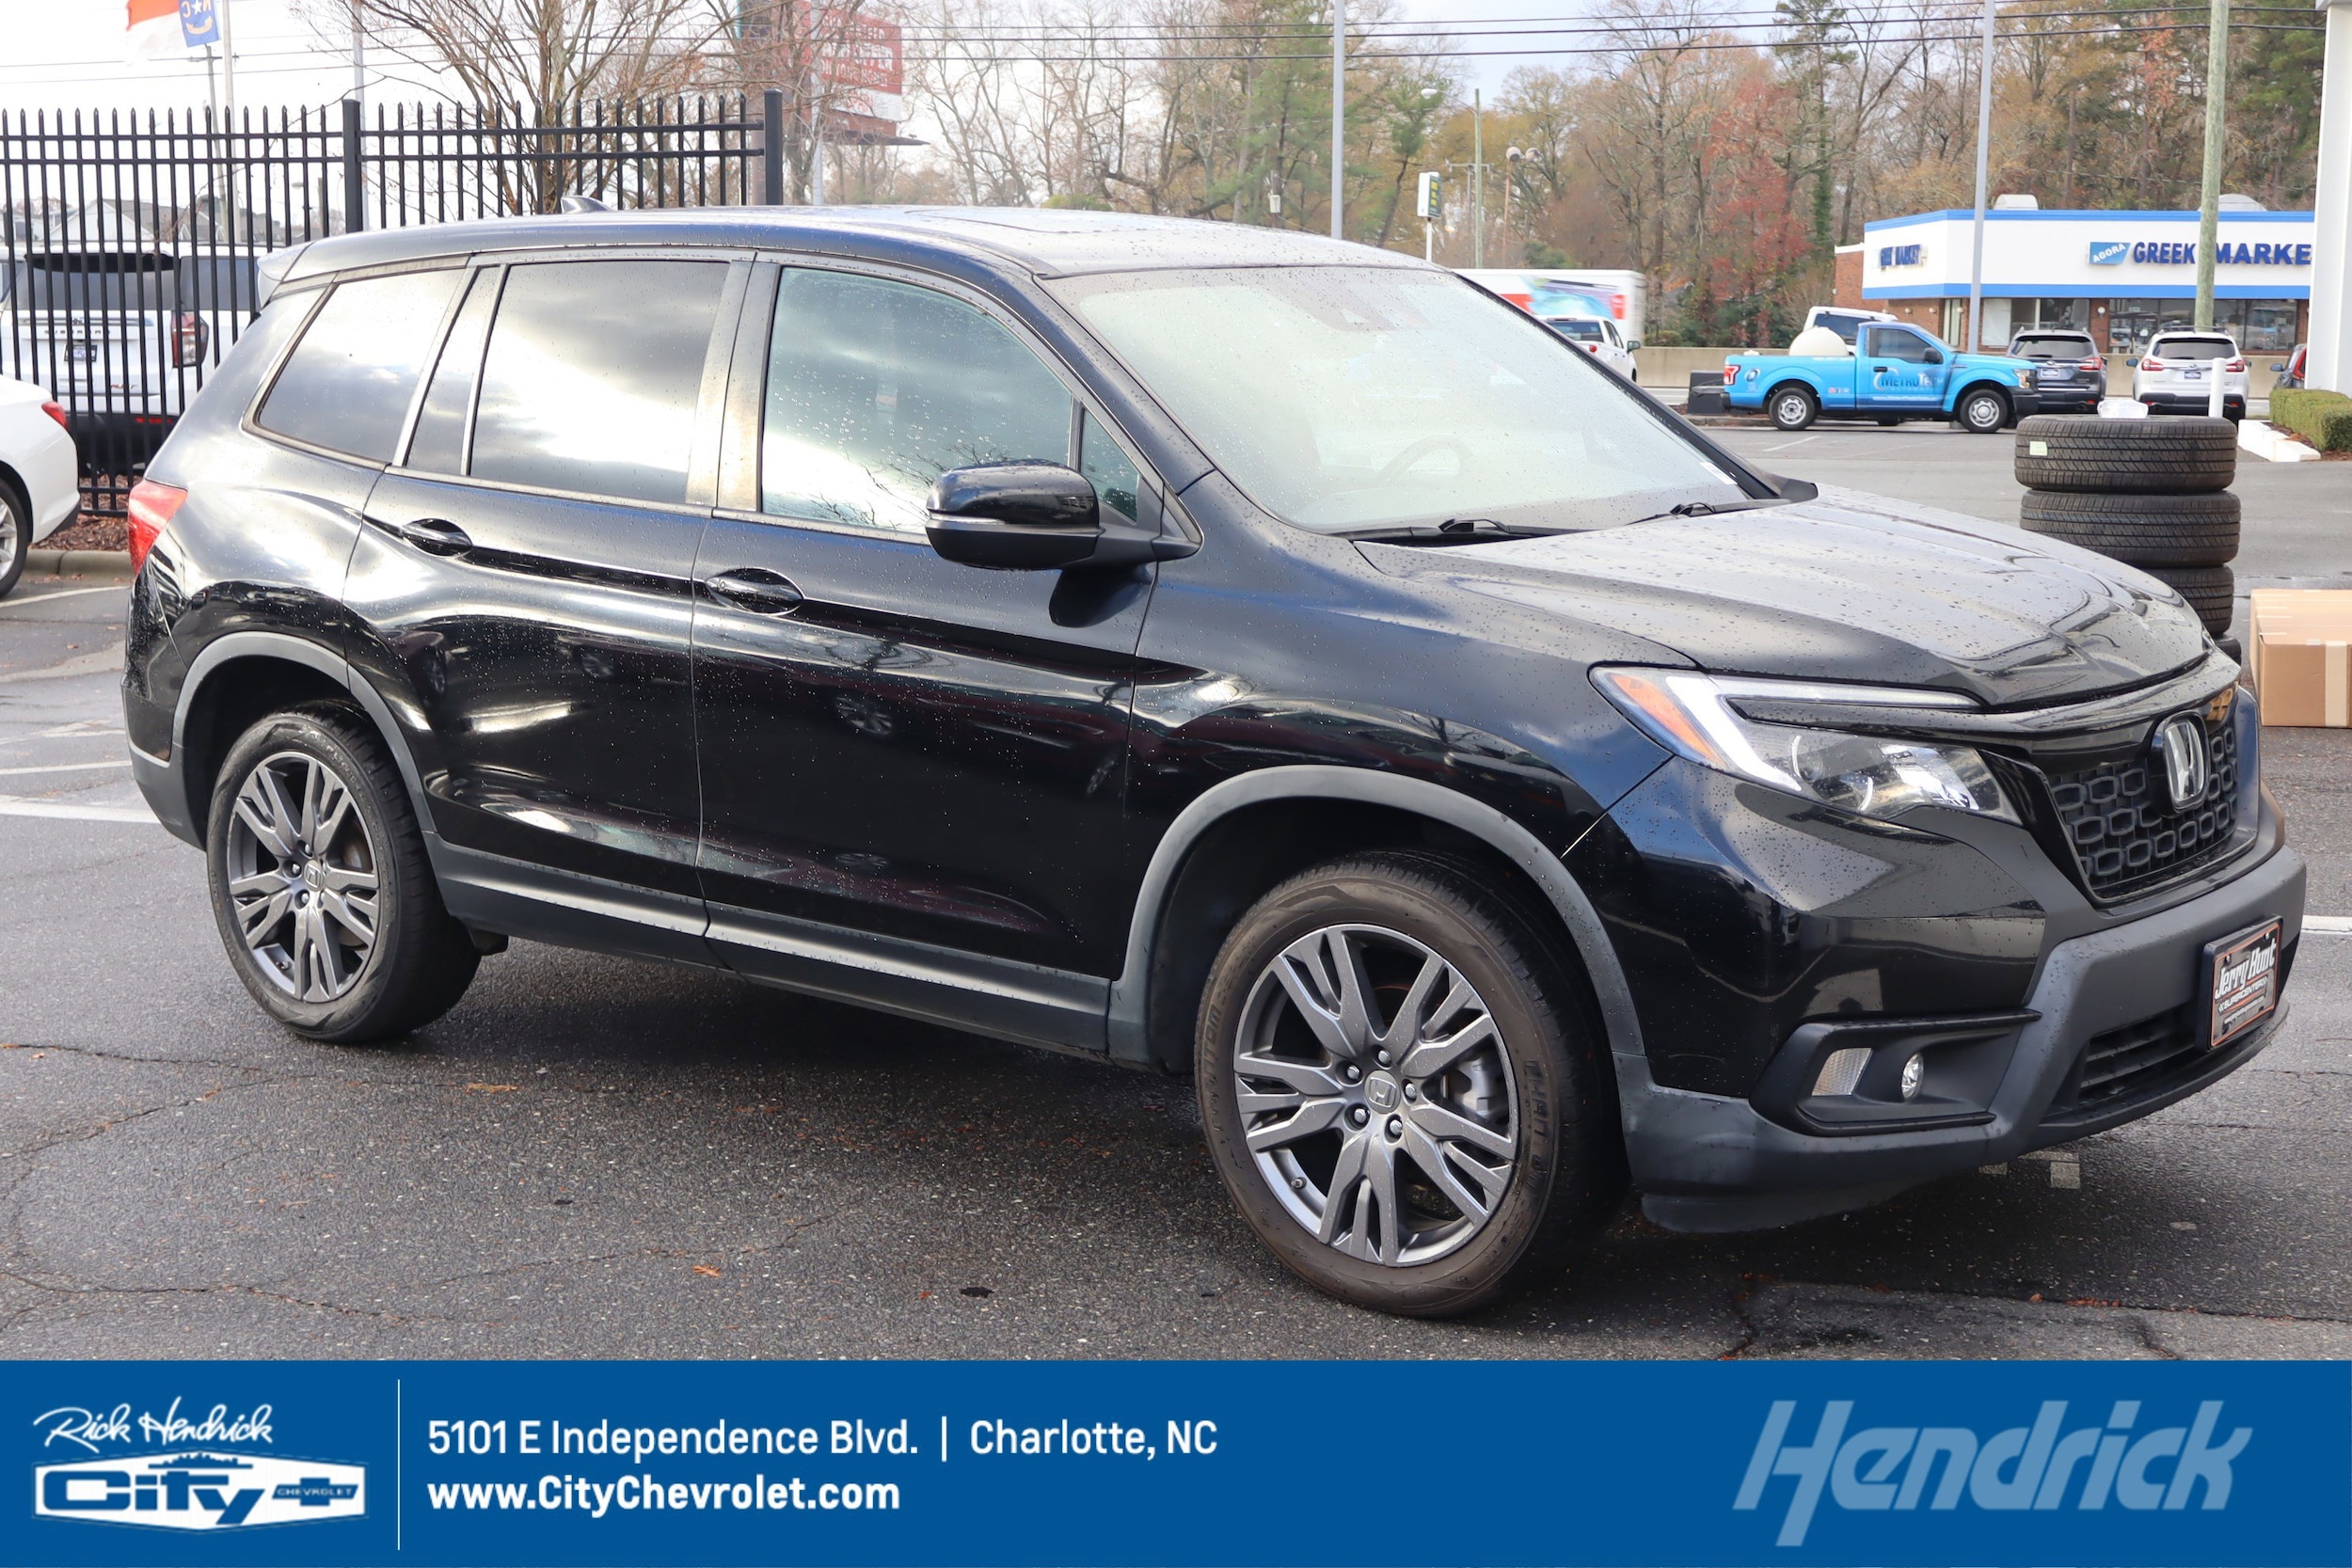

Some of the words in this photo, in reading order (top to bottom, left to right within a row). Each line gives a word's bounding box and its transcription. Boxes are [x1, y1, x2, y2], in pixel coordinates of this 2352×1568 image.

[2092, 243, 2126, 263] AGORA
[2134, 242, 2196, 264] GREEK
[2216, 243, 2312, 265] MARKE
[2215, 959, 2249, 1000] Jerry
[2248, 938, 2277, 980] Hunt
